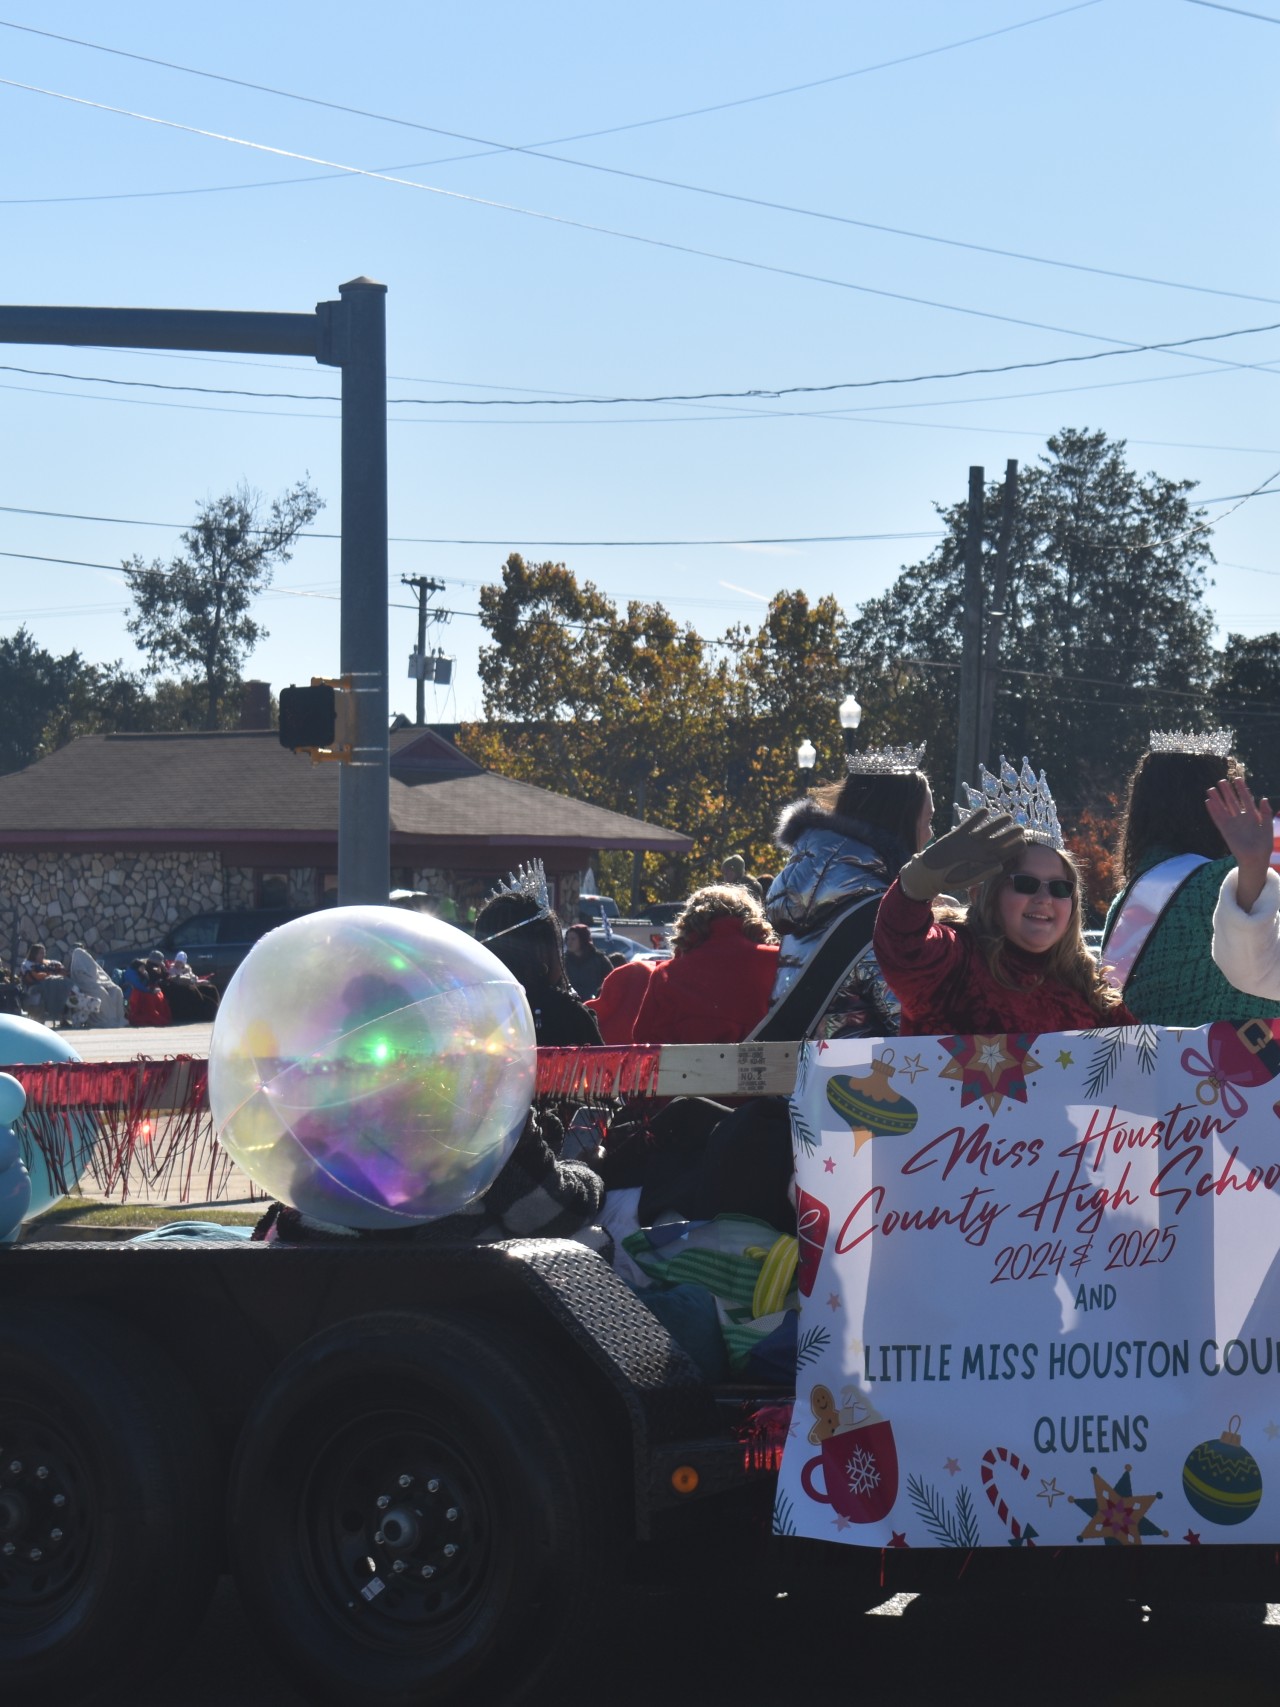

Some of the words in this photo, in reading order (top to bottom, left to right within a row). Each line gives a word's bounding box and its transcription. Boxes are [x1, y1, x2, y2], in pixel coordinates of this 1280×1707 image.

[901, 1123, 1044, 1181] Miss
[1058, 1103, 1237, 1172] Houston
[834, 1186, 1011, 1255] County
[1017, 1161, 1139, 1234] High
[990, 1239, 1067, 1284] 2024
[1104, 1225, 1179, 1271] 2025
[1073, 1283, 1117, 1312] AND
[864, 1344, 952, 1382] LITTLE
[961, 1343, 1039, 1381] MISS
[1049, 1339, 1190, 1380] HOUSTON
[1033, 1415, 1149, 1454] QUEENS
